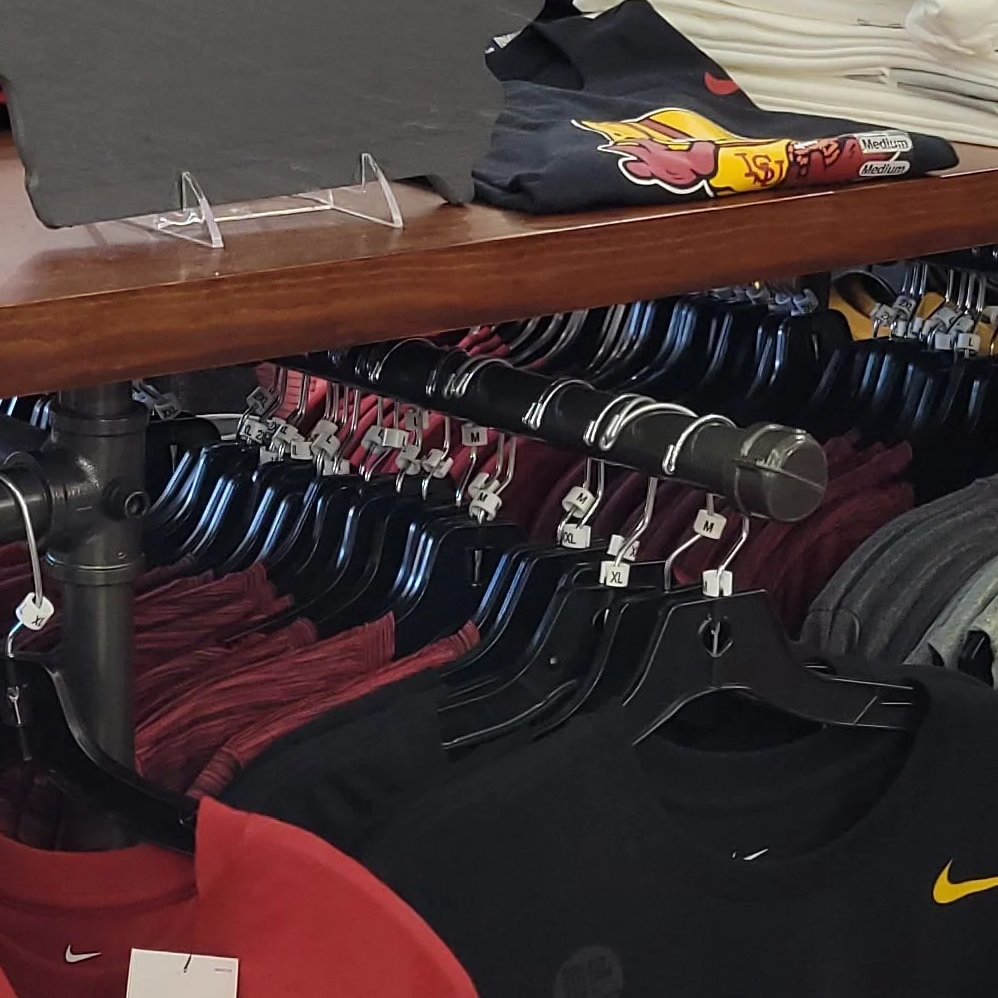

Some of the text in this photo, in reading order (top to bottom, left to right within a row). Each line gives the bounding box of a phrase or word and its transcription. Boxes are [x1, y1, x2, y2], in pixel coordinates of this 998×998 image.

[861, 138, 910, 151] Medium
[860, 163, 907, 176] Medium
[470, 432, 480, 443] M
[703, 520, 714, 533] M
[609, 571, 623, 584] XL
